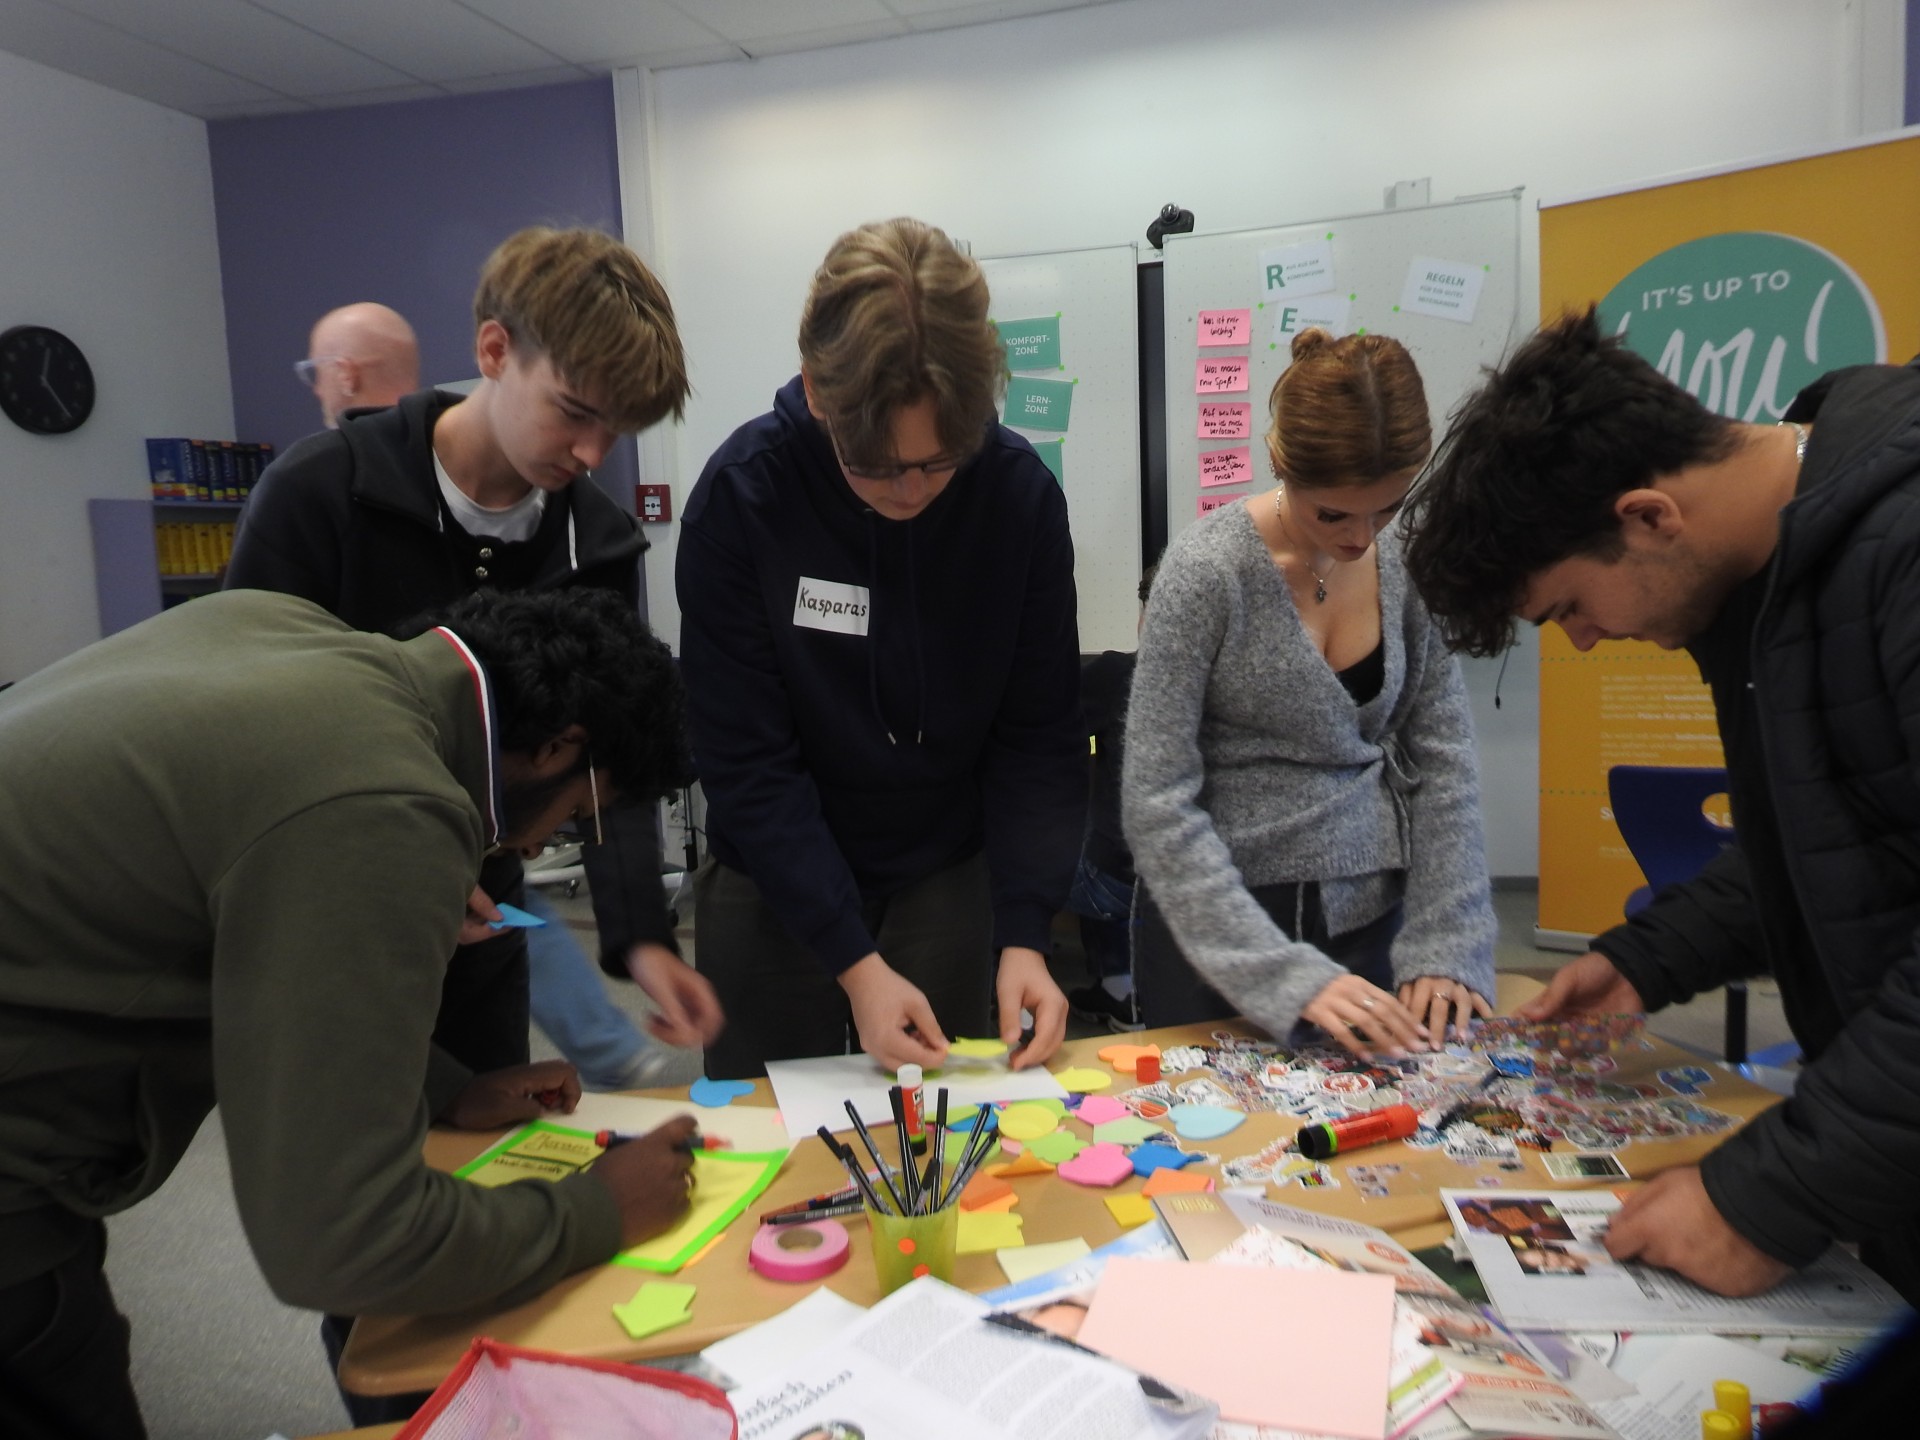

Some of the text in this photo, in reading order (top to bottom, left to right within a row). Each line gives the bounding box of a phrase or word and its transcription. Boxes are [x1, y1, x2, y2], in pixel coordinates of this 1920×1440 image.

[1266, 264, 1286, 290] R
[1425, 271, 1466, 287] REGELN
[1641, 269, 1791, 311] IT'S UP TO
[1005, 334, 1051, 346] KOMFORT-
[1015, 346, 1039, 356] ZONE
[1204, 364, 1217, 374] Was
[1214, 375, 1238, 390] Spaß?
[1026, 394, 1052, 404] LERN-
[1025, 404, 1049, 415] ZONE
[798, 586, 867, 618] Kasparas
